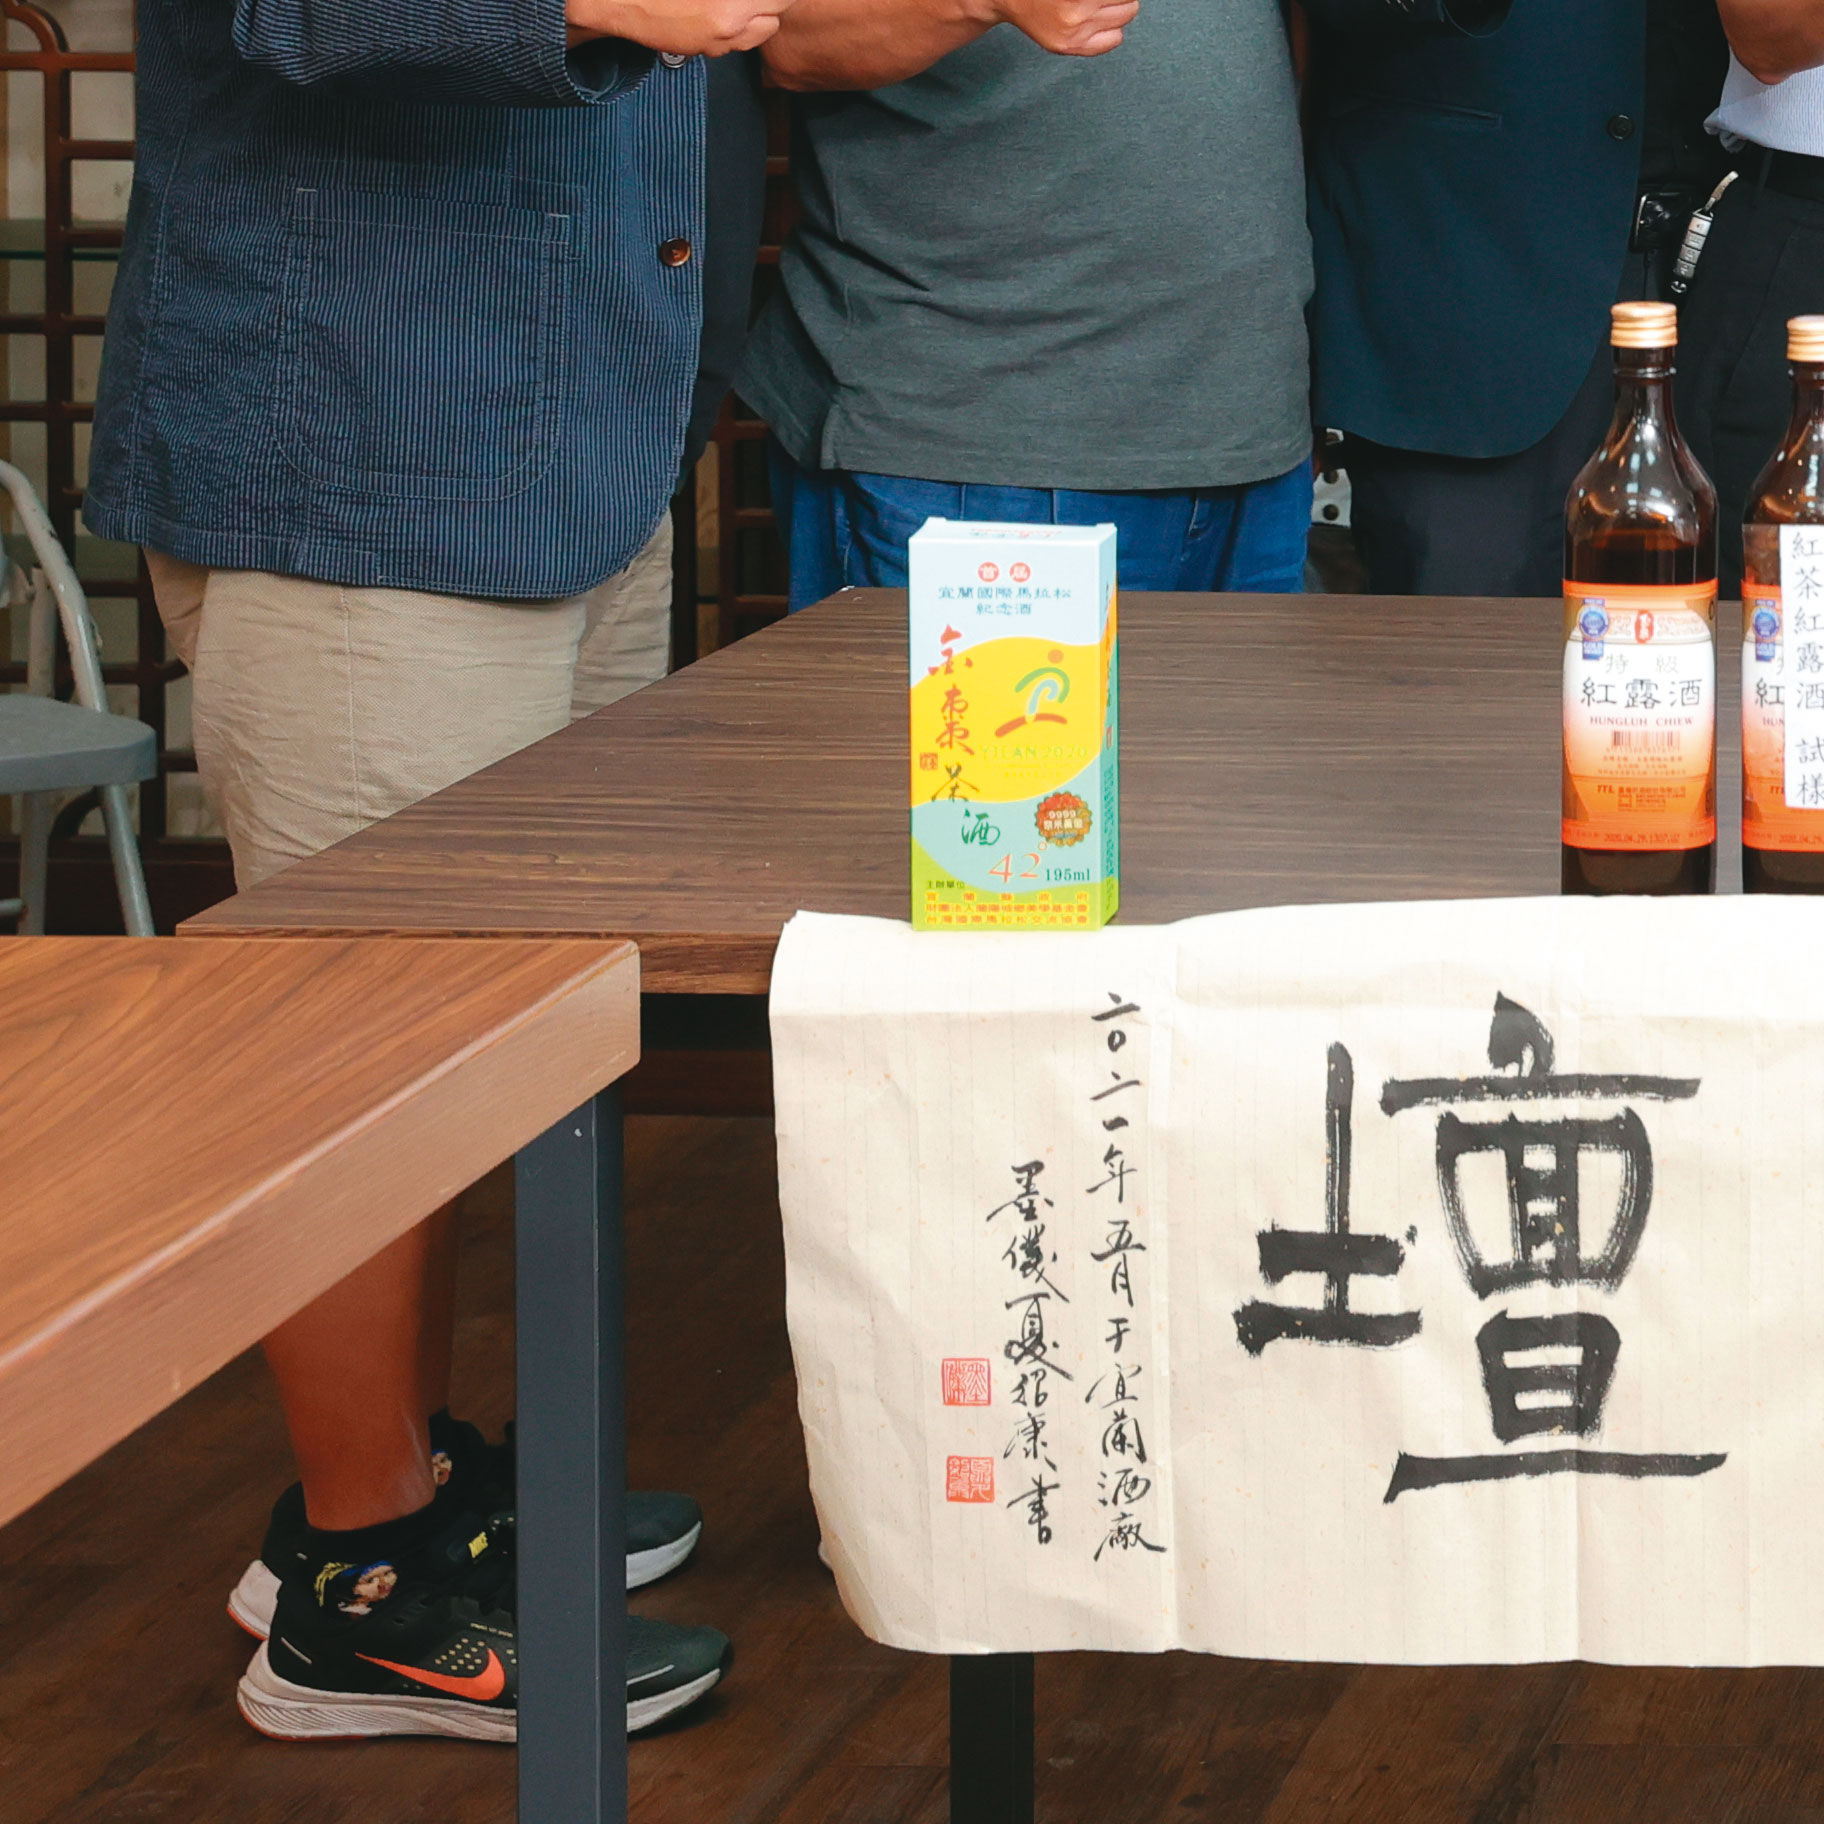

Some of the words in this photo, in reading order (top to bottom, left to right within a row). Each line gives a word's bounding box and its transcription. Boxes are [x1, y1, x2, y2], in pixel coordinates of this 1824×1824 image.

[1580, 676, 1702, 709] 紅露酒
[1656, 717, 1694, 726] CHIEW
[1049, 810, 1077, 819] 9999
[1045, 868, 1091, 882] 195ml
